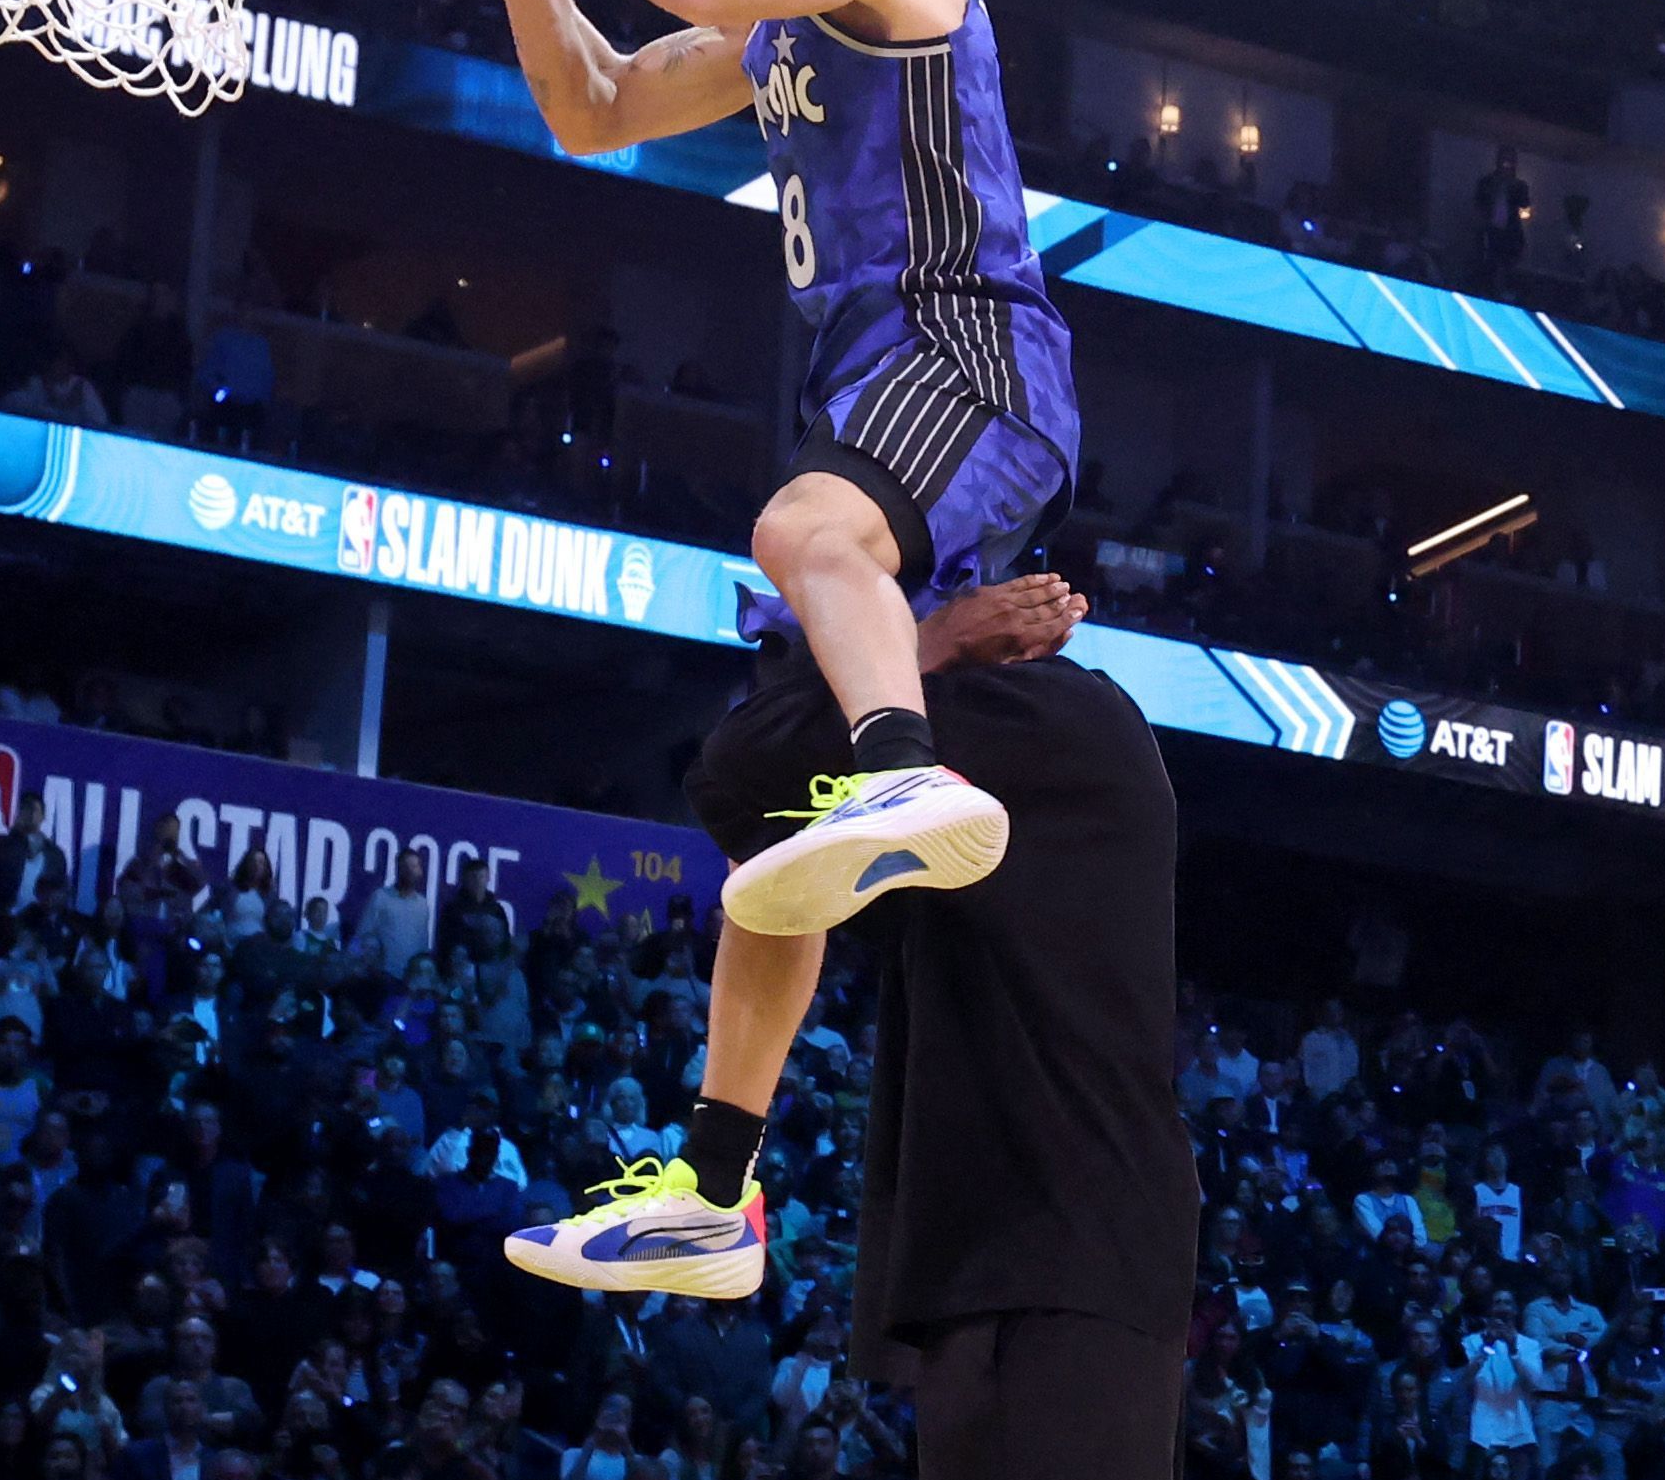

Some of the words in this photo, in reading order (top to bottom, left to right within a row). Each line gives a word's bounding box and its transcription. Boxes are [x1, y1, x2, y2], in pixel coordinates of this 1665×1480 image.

[782, 173, 816, 289] 8
[242, 491, 326, 539] AT&T
[378, 491, 494, 590] SLAM
[498, 517, 612, 617] DUNK
[1429, 718, 1514, 767] AT&T
[1582, 734, 1662, 804] SLAM
[629, 848, 683, 885] 104
